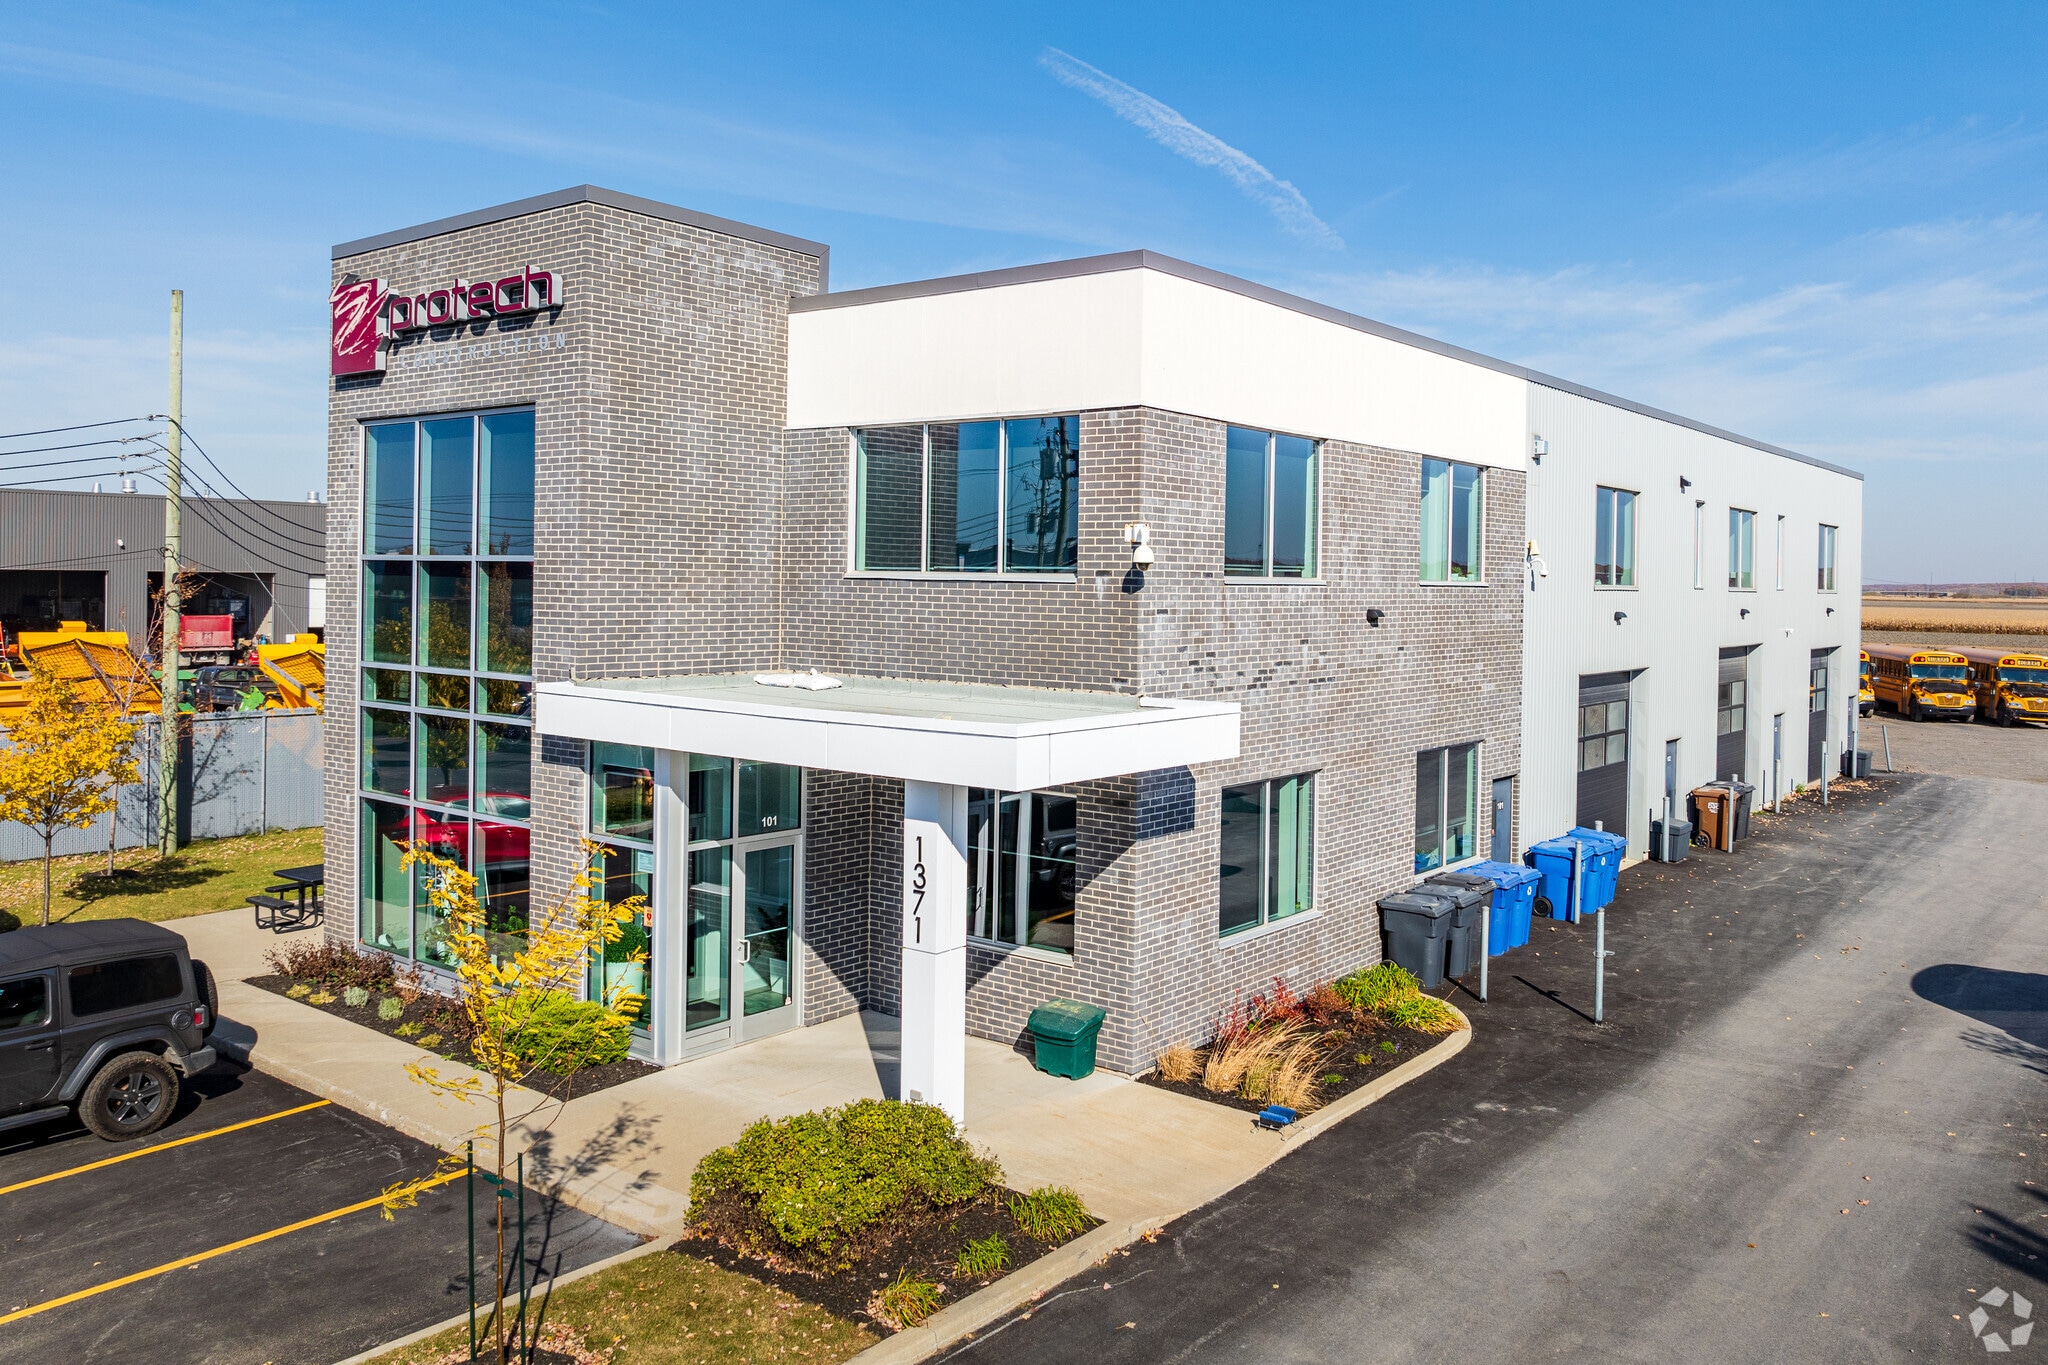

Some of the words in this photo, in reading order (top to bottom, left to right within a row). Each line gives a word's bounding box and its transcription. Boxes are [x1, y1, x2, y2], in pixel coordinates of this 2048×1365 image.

[389, 264, 558, 339] protech
[400, 332, 567, 370] CONSTRUCTION
[761, 815, 777, 828] 101
[912, 835, 927, 944] 1371
